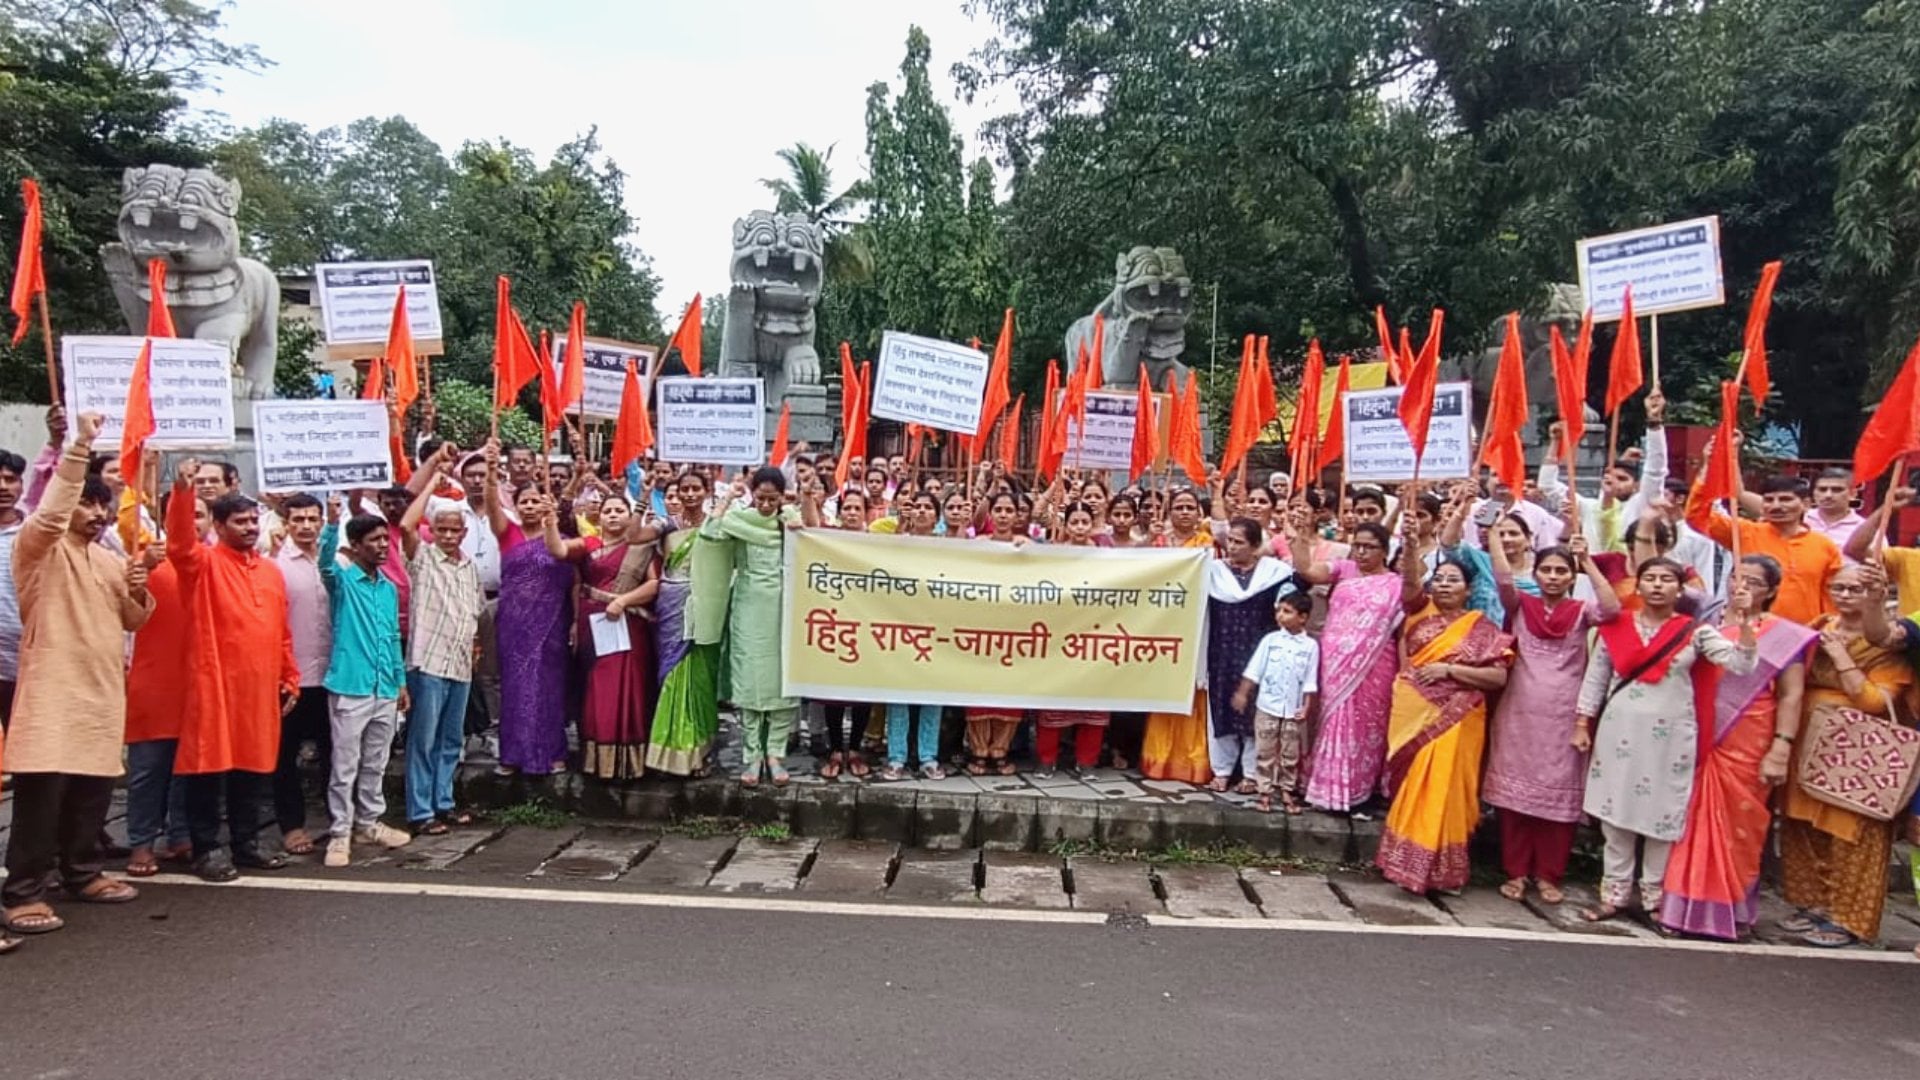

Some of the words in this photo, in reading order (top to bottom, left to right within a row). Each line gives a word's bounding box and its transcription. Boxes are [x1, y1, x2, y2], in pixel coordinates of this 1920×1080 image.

[806, 563, 919, 602] हिंदुत्वनिष्ठ
[926, 574, 1000, 604] संघटना
[1010, 581, 1061, 607] आणि
[1071, 582, 1142, 611] संप्रदाय
[1148, 582, 1189, 610] यांचे
[806, 609, 861, 663] हिंदु
[872, 623, 1051, 667] राष्ट्र-जागृती
[1062, 625, 1182, 665] आंदोलन
